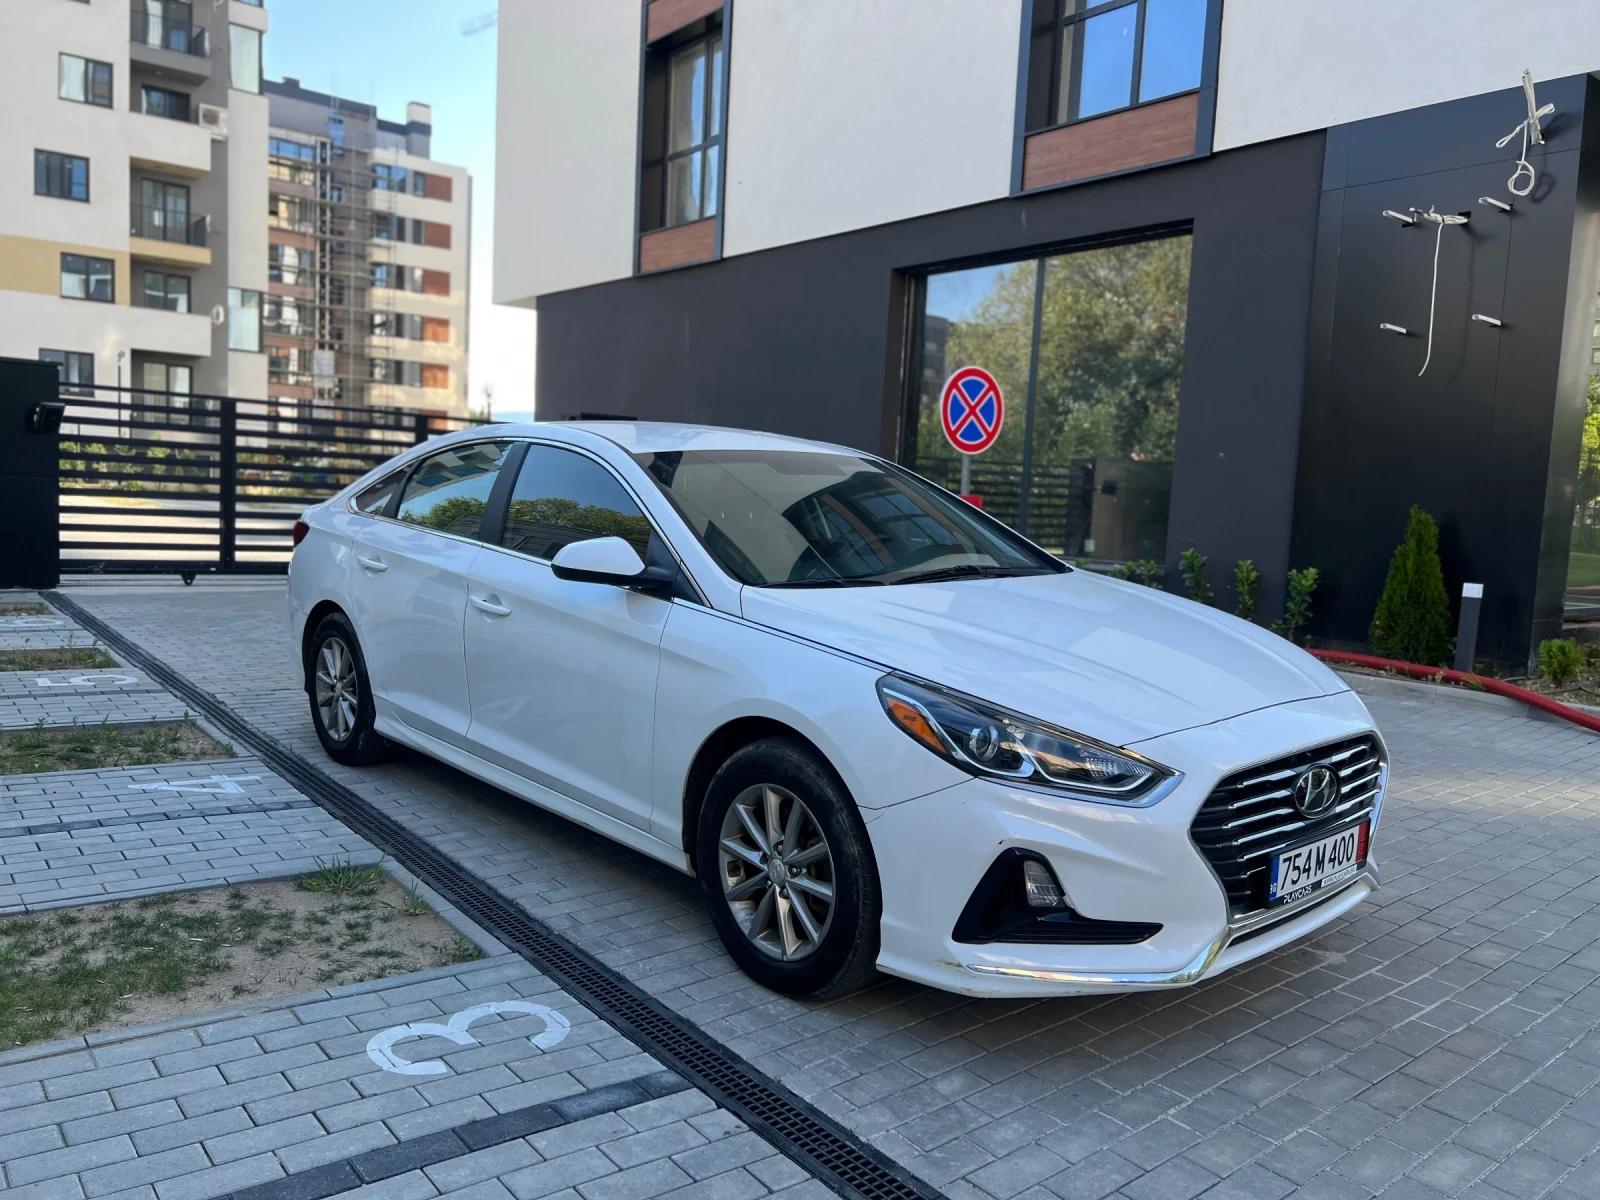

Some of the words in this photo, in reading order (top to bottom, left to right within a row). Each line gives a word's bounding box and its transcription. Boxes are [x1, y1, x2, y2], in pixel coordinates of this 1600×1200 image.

[34, 674, 138, 687] 5
[128, 773, 262, 794] 4
[1283, 885, 1312, 904] PLAYCARS
[366, 1000, 571, 1076] 3
